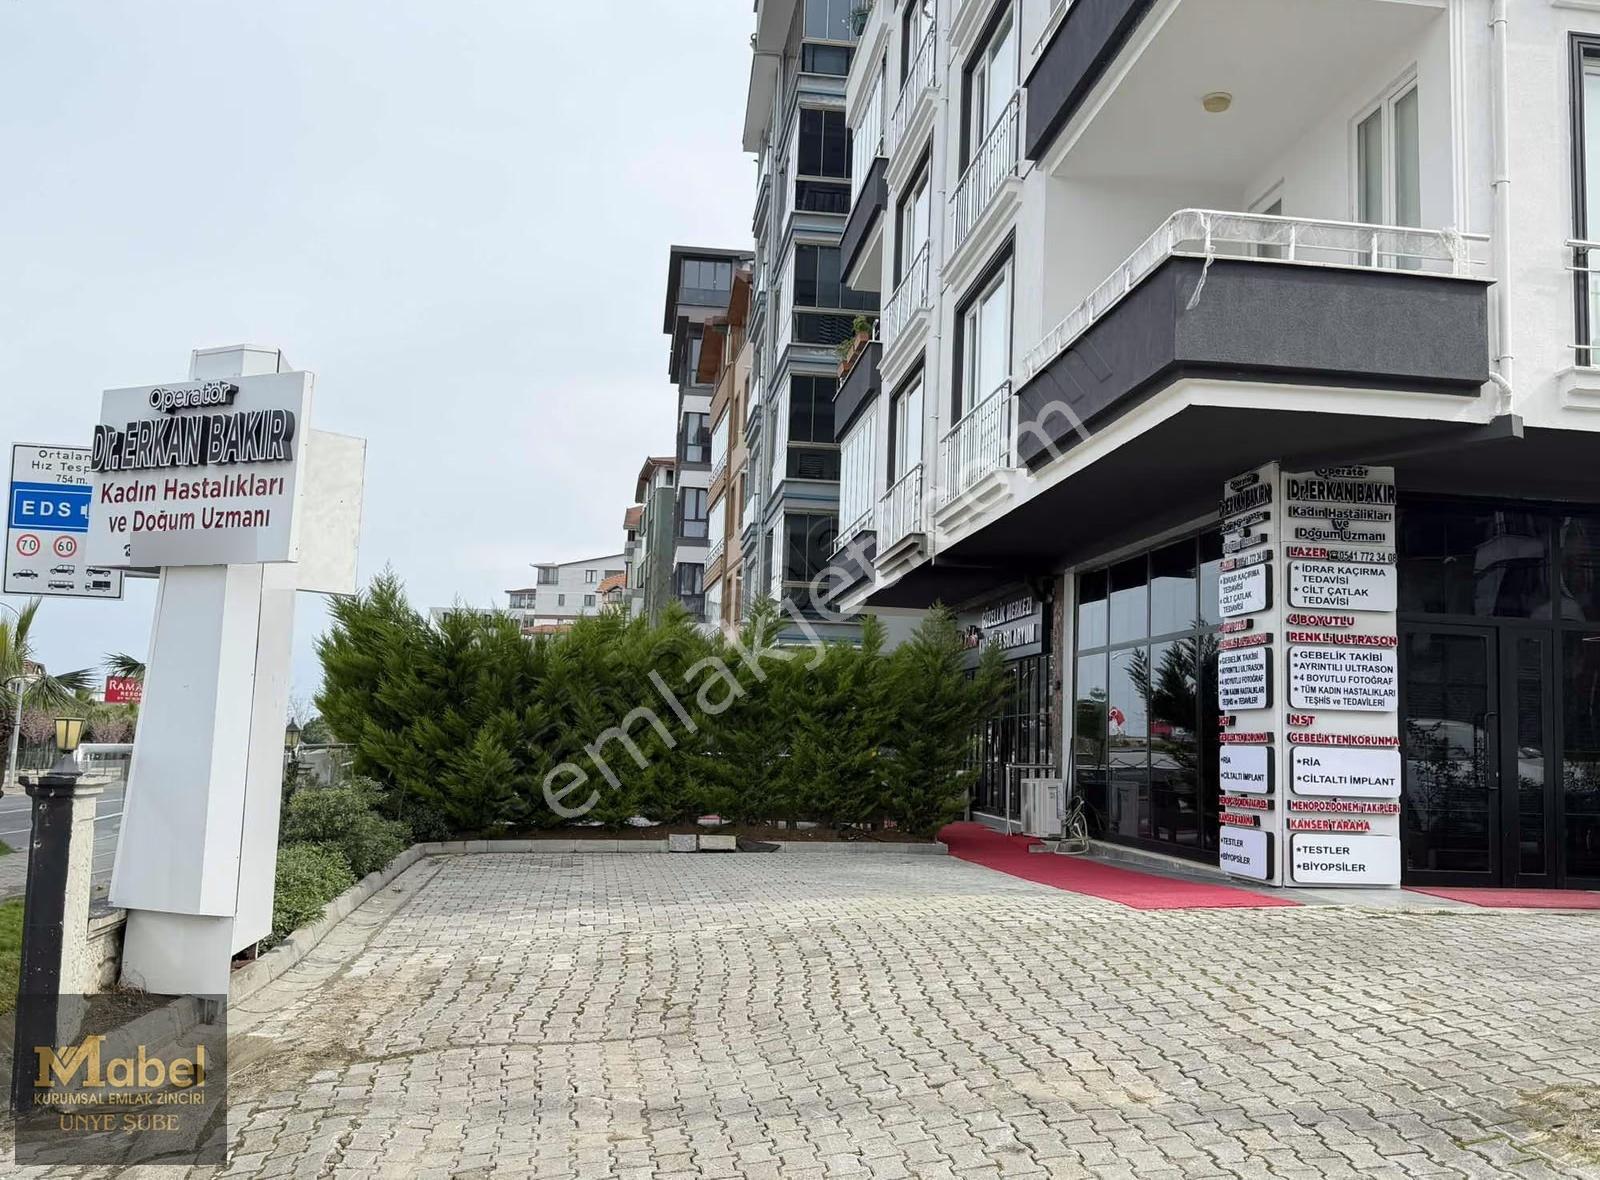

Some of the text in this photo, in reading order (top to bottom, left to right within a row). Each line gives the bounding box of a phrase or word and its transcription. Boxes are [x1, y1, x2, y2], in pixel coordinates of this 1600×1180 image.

[149, 382, 237, 412] Operatör
[208, 409, 293, 464] BAKIR
[60, 462, 91, 474] Tesp
[56, 474, 73, 483] 754
[101, 473, 284, 504] Kadın Hastalıkları
[1356, 483, 1397, 504] BAKIR
[21, 501, 71, 516] EDS
[1292, 506, 1325, 517] Kadın
[108, 507, 270, 532] ve Doğum Uzmanı
[1335, 520, 1350, 528] ve
[1299, 528, 1340, 540] Doğum
[21, 540, 73, 551] 70 60
[1290, 547, 1327, 557] LAZER
[1339, 551, 1358, 560] 0541
[1360, 552, 1374, 561] 772
[1376, 552, 1386, 561] 34
[1301, 563, 1387, 577] İDRAR KAÇIRMA
[1301, 575, 1349, 585] TEDAVİSİ
[1302, 585, 1369, 597] CİLT ÇATLAK
[1301, 596, 1350, 606] TEDAVİSİ
[1300, 615, 1356, 626] BOYUTLU
[1336, 634, 1398, 646] ULTRASON
[1300, 650, 1383, 662] GEBELİK TAKİBİ
[1299, 662, 1393, 673] AYRINTILI ULTRASON
[1306, 674, 1346, 683] BOYUTLU
[1348, 675, 1394, 685] FOTOĞRAF
[1301, 685, 1396, 697] TÜM KADIN HASTALIKLARI
[1305, 695, 1331, 705] TEŞHİS
[1343, 697, 1385, 707] TEDAVİLERİ
[1291, 715, 1315, 725] NST
[1351, 735, 1399, 745] KORUNMA
[1303, 757, 1321, 766] RİA
[1303, 774, 1396, 786] CİLTALTI İMPLANT
[1291, 819, 1371, 831] KANSER TARAMA
[1302, 846, 1350, 855] TESTLER
[1302, 861, 1366, 872] BİYOPSİLER
